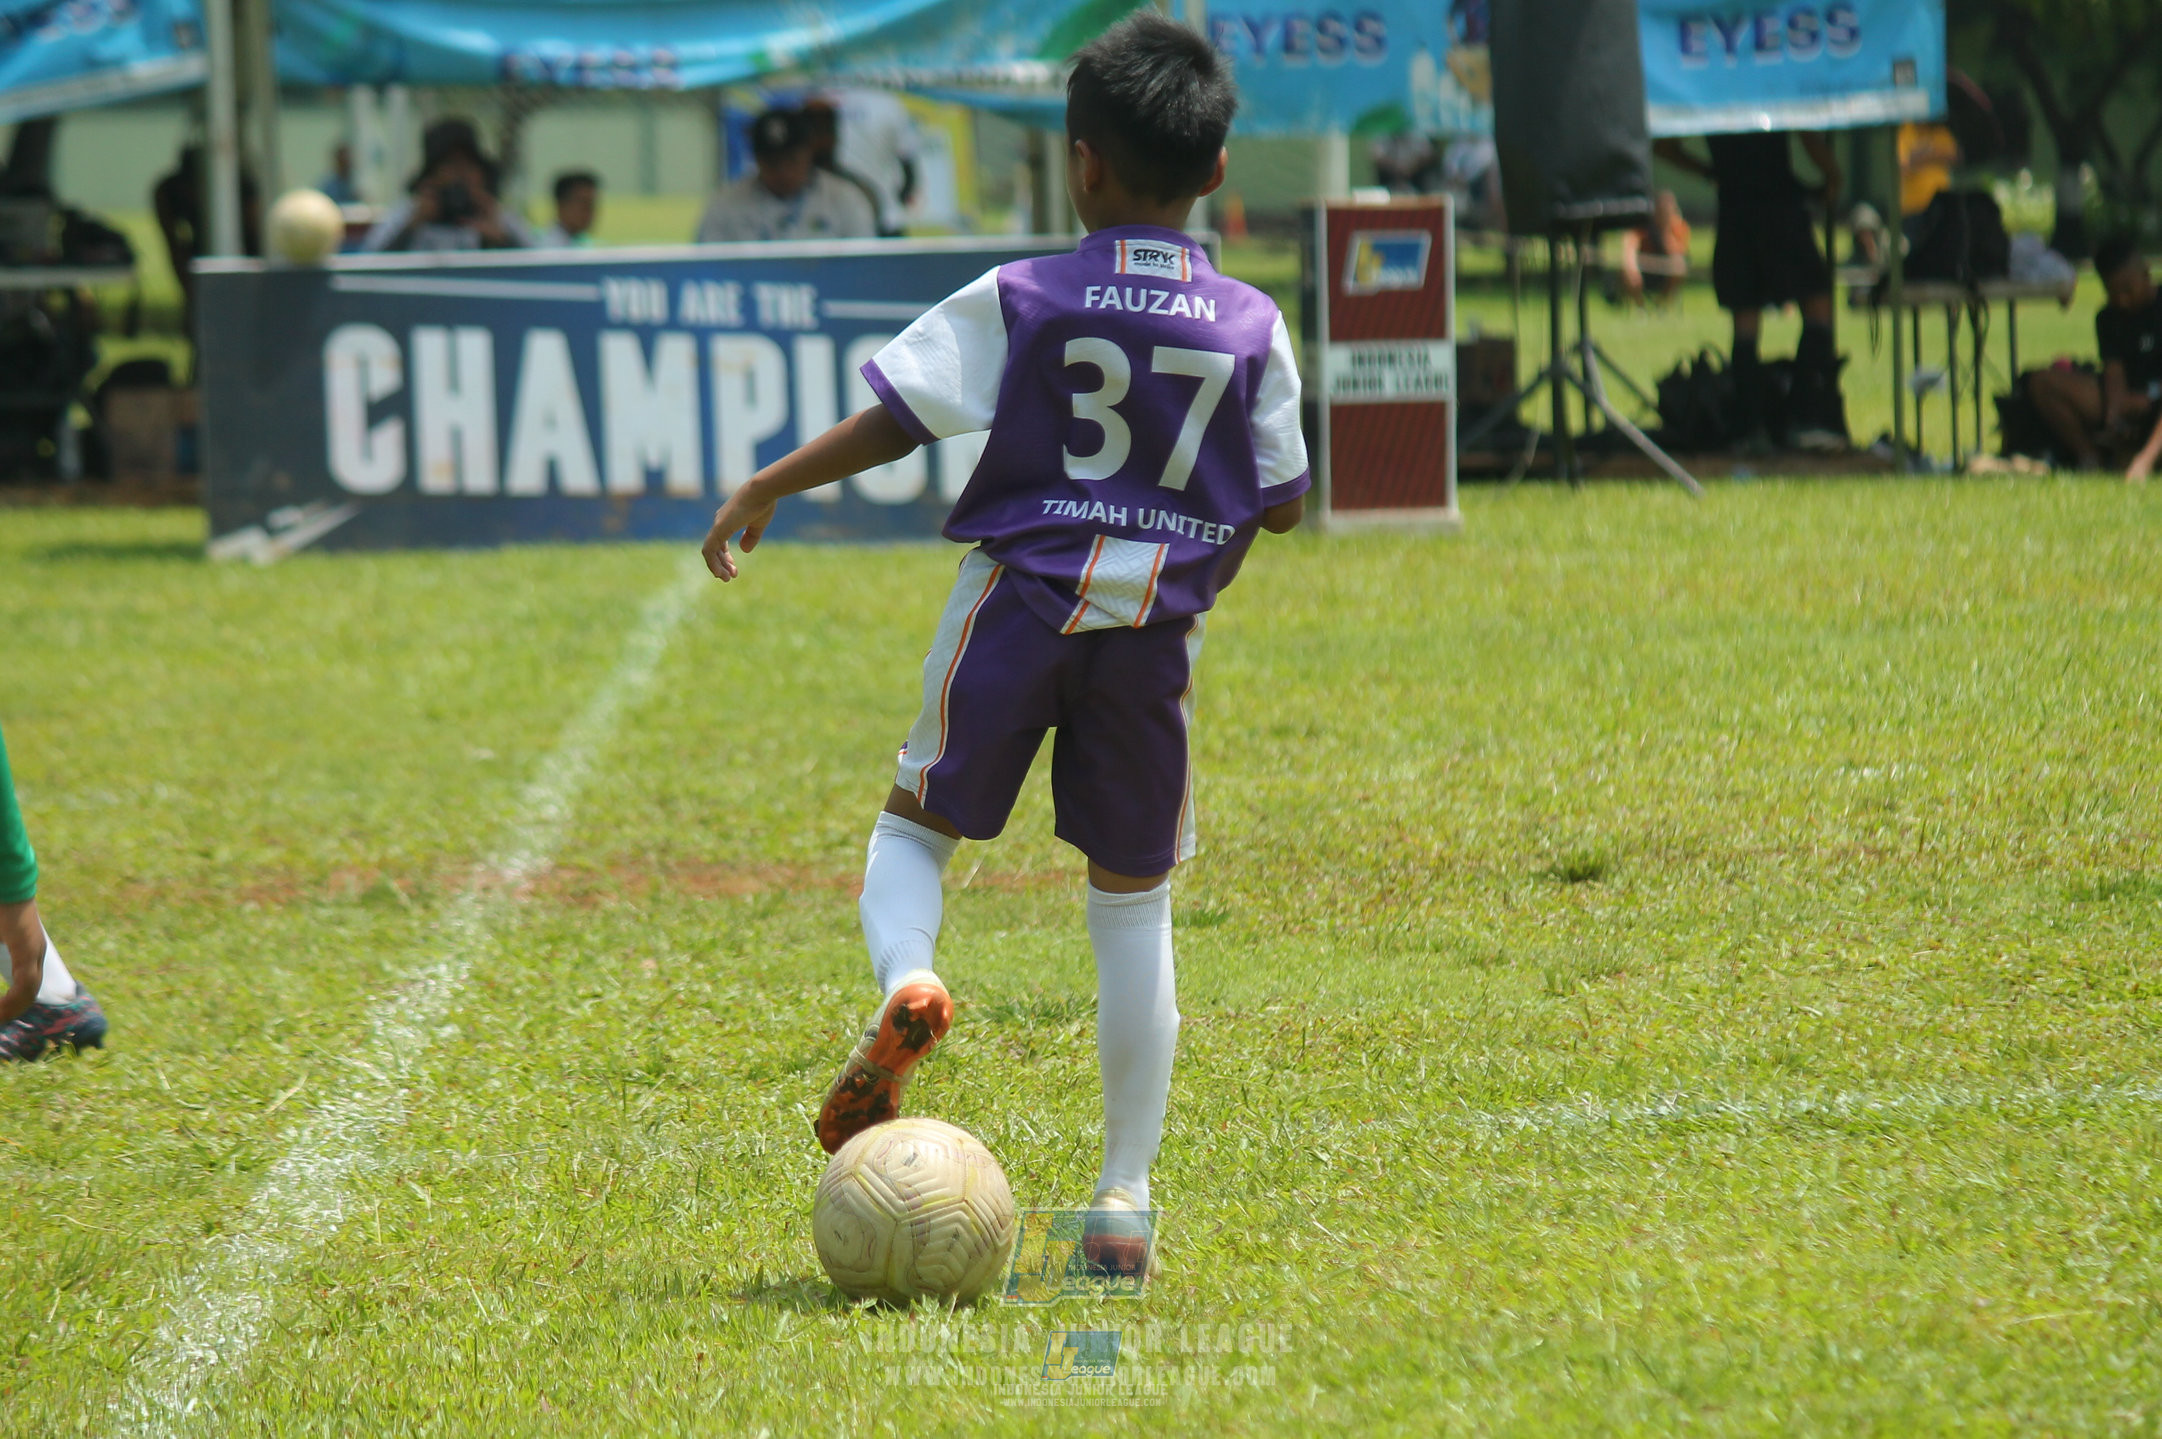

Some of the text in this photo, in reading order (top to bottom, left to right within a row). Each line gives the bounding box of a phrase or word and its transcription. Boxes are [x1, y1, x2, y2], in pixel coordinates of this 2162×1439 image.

[1210, 10, 1389, 68] EYESS
[1680, 2, 1861, 69] EYESS
[602, 275, 820, 331] YOU ARE THE
[1084, 285, 1217, 323] FAUZAN
[321, 320, 992, 505] CHAMPIO
[1063, 337, 1236, 492] 37
[1042, 499, 1236, 546] TIMAH UNITED
